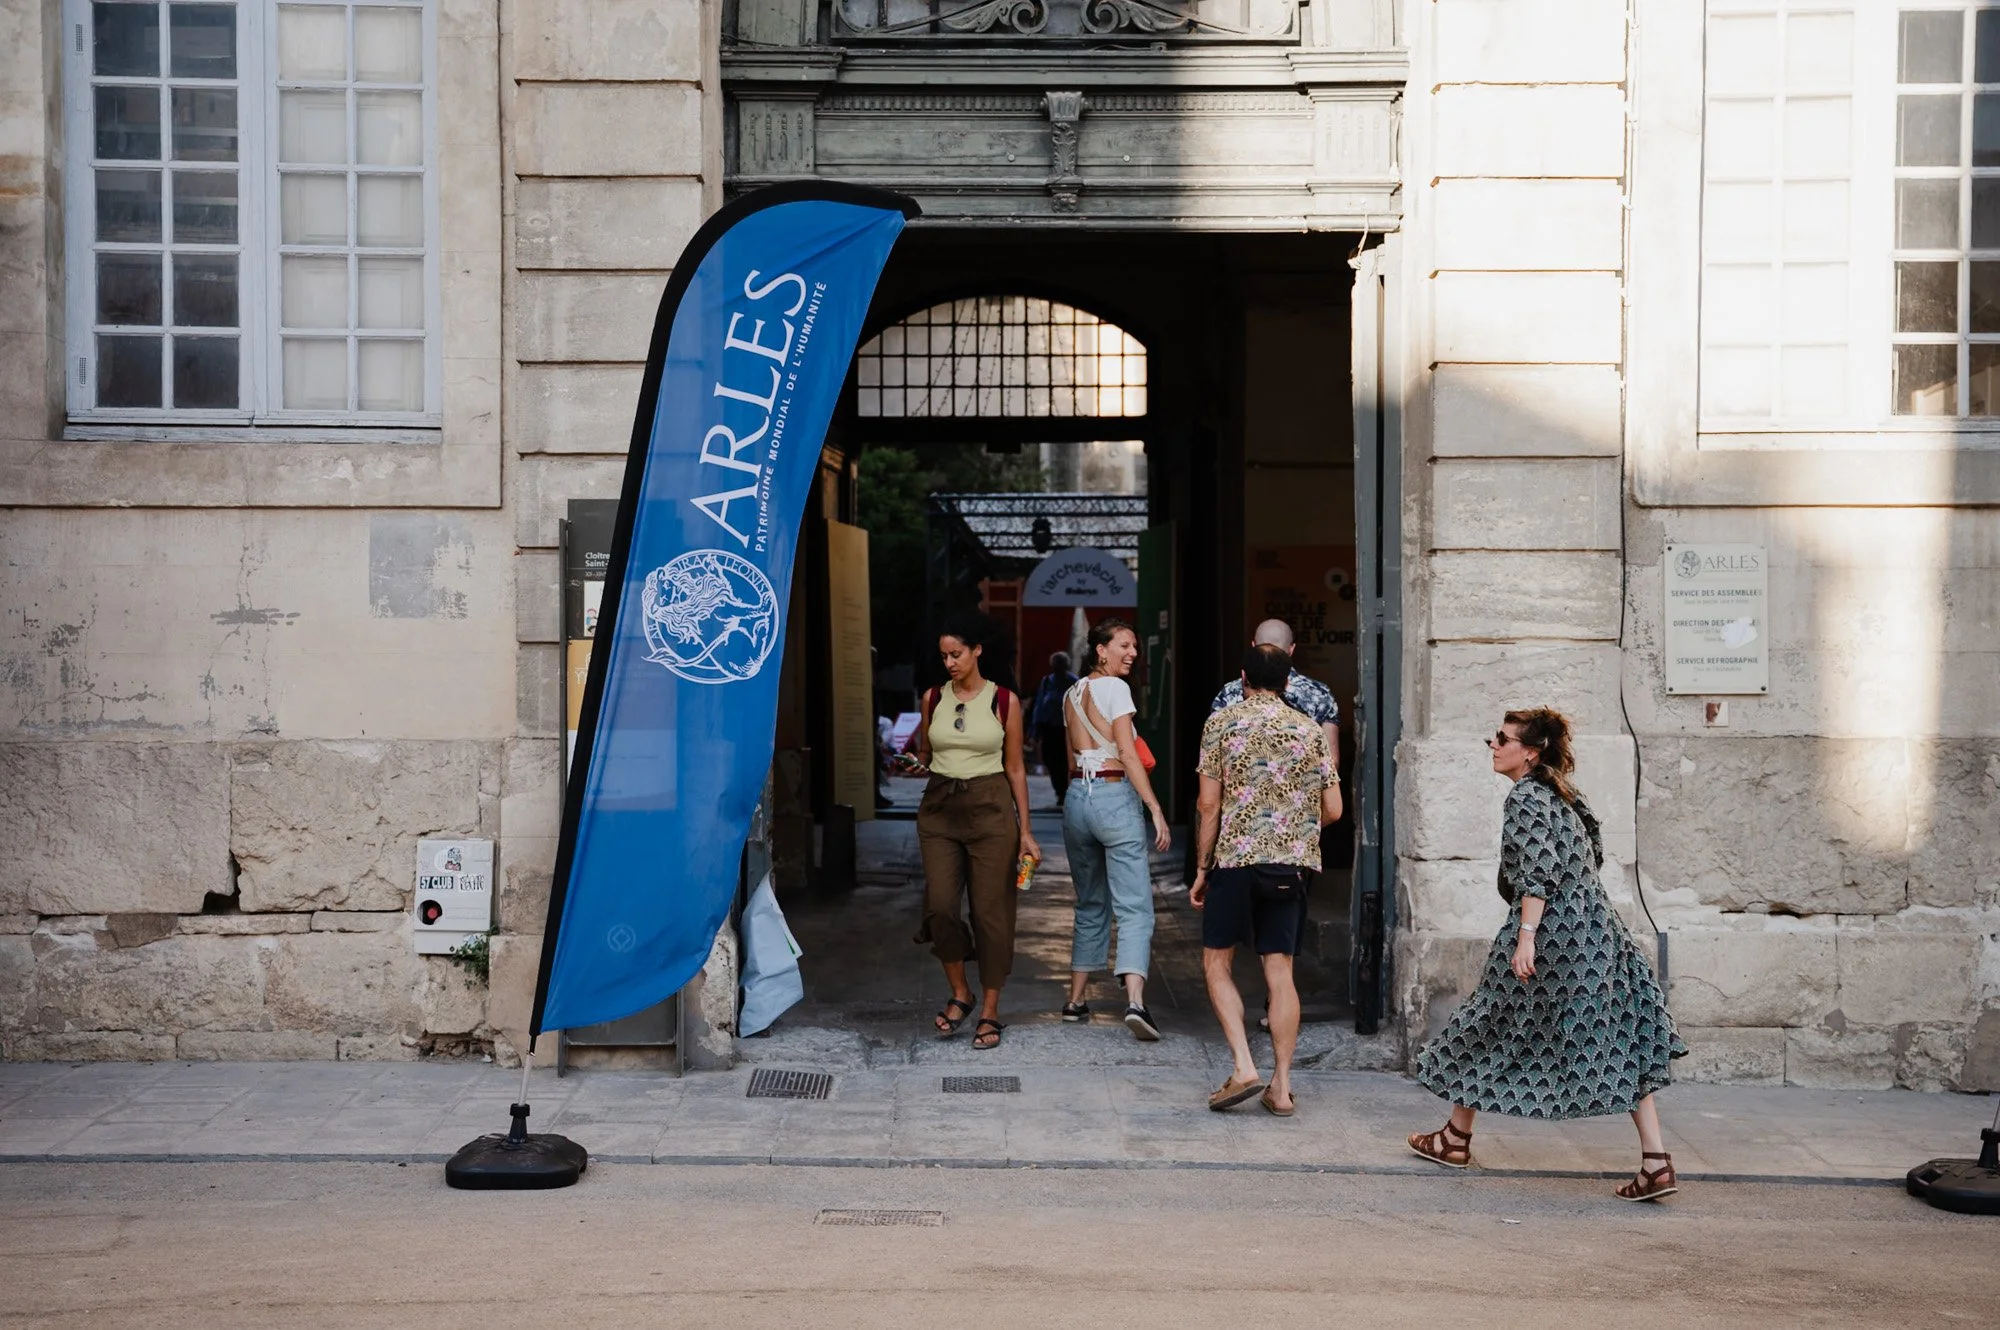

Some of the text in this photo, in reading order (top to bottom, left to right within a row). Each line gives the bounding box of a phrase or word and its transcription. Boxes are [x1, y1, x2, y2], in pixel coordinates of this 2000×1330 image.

[690, 269, 807, 548] ARLES
[755, 465, 776, 552] PATRIMOINE
[768, 396, 791, 461] MONDIAL
[786, 372, 798, 392] DE
[1702, 555, 1760, 569] ARLES
[675, 555, 703, 572] IRA
[724, 556, 767, 594] LEONIS
[1265, 602, 1328, 616] QUELLE
[1303, 616, 1324, 630] DE
[1673, 619, 1710, 627] DIRECTION
[1711, 619, 1725, 627] DES
[1316, 630, 1354, 645] VOIR
[1676, 657, 1705, 665] SERVICE
[432, 877, 452, 888] CLUB
